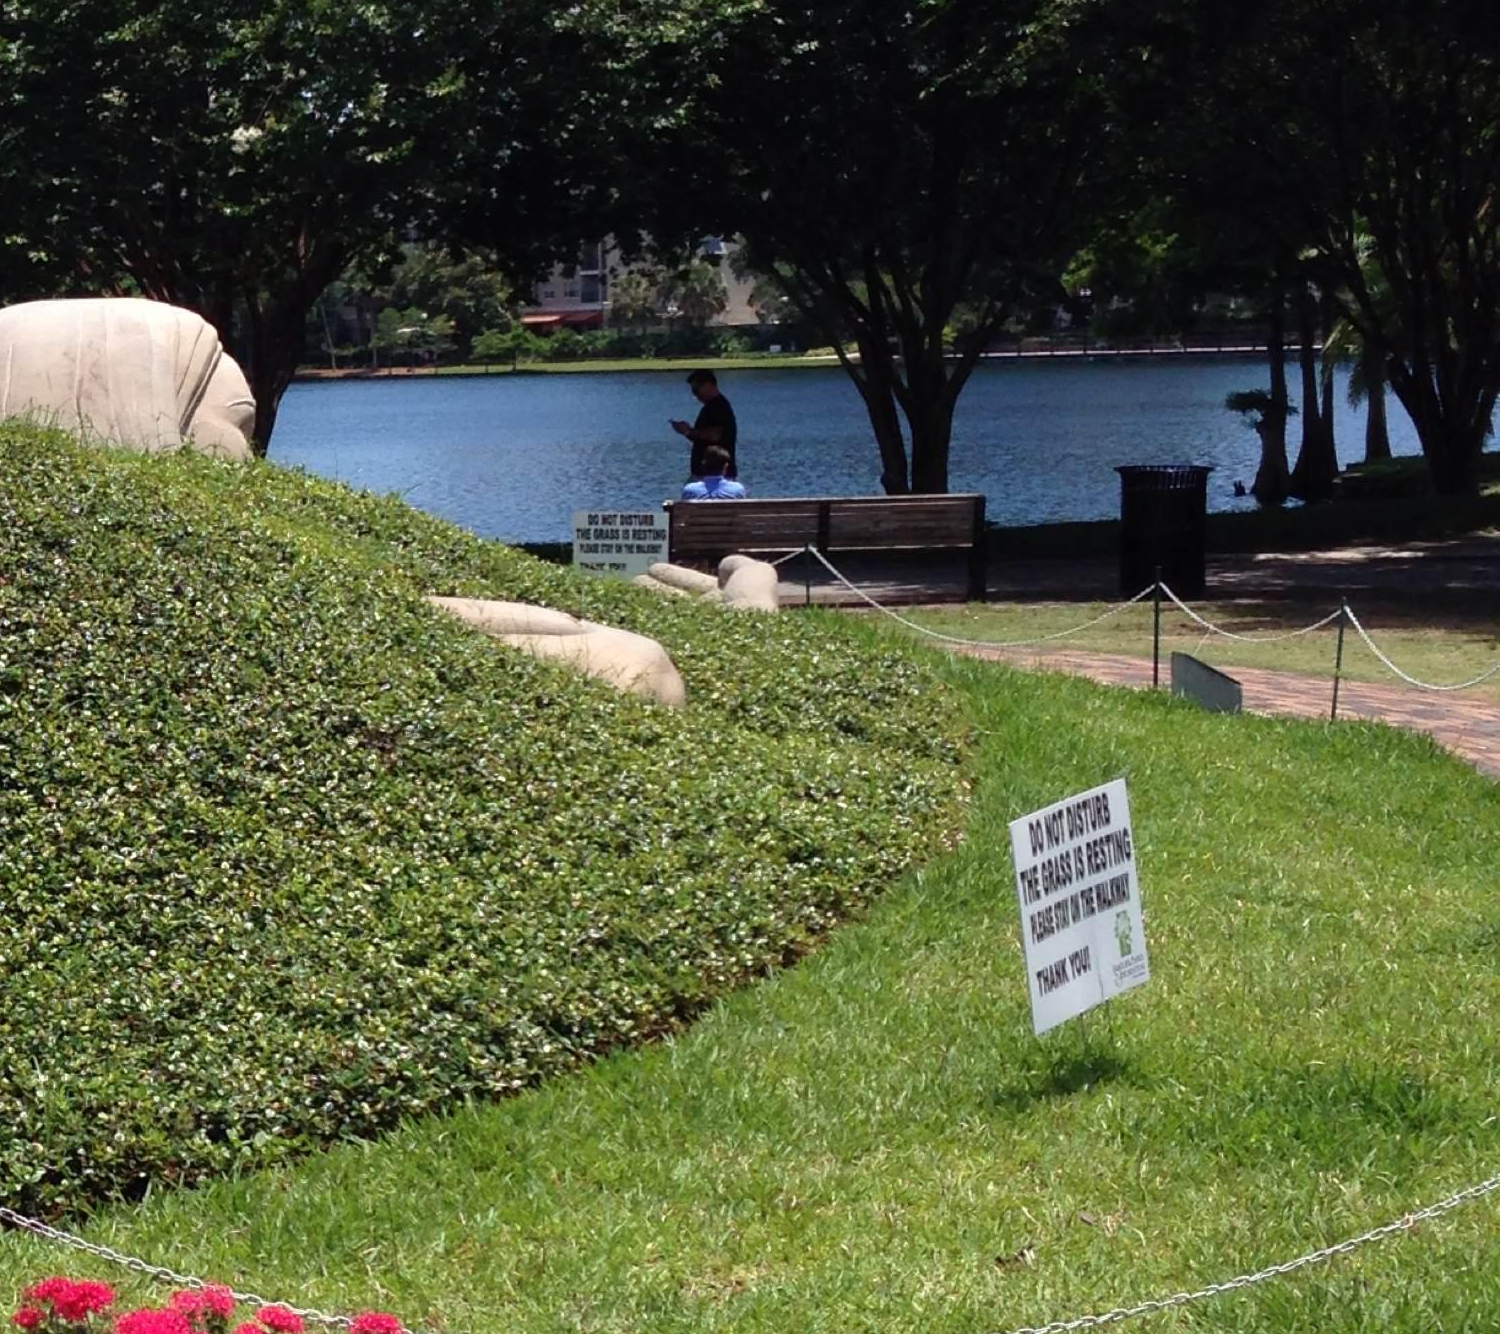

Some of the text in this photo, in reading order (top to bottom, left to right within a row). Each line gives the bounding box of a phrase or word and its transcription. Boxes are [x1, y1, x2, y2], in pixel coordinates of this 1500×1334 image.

[576, 528, 666, 541] THE GRASS IS RESTING
[1028, 792, 1110, 857] DO NOT DISTURB
[1020, 827, 1132, 906] THE GRASS IS RESTING
[1030, 872, 1130, 946] PLEASE STAY ON THE WALKWAY
[1036, 955, 1069, 997] THANK
[1068, 945, 1091, 980] YOU!
